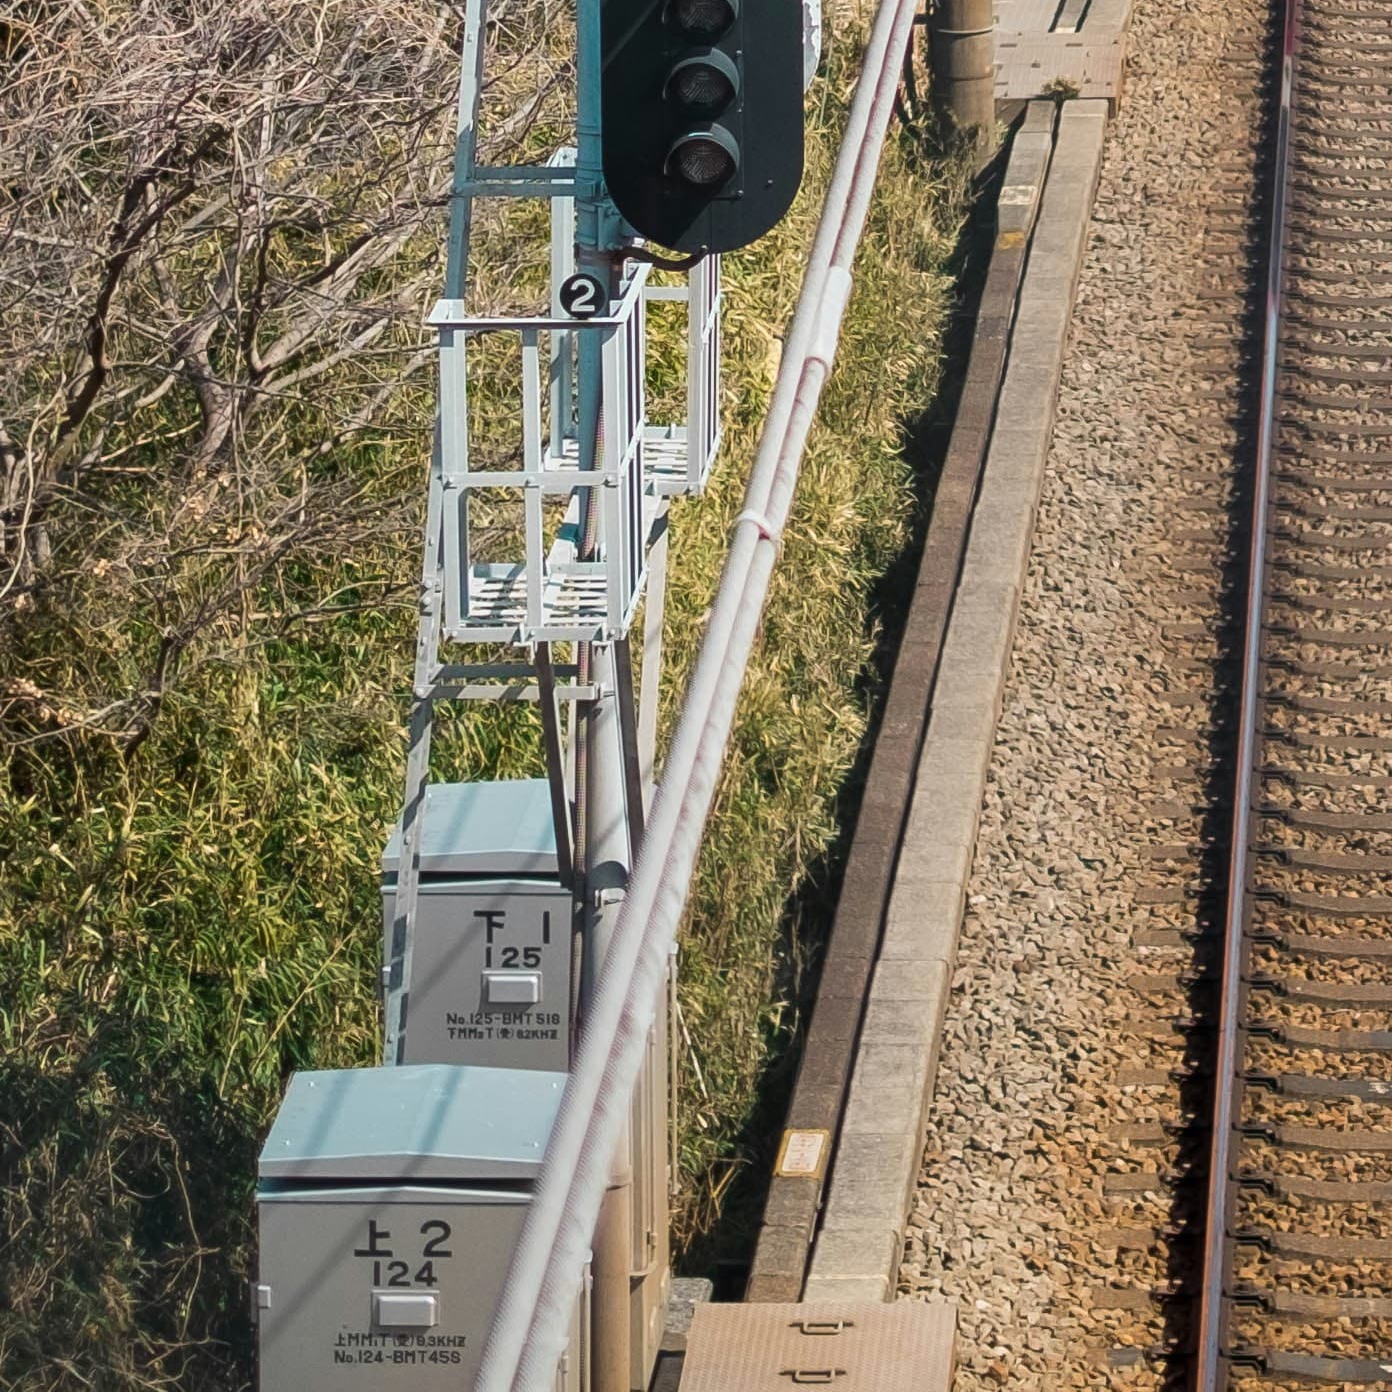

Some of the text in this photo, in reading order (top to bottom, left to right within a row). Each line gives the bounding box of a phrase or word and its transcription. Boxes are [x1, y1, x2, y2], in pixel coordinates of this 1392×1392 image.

[571, 279, 595, 312] 2
[473, 910, 506, 944] 下
[485, 947, 542, 968] 125
[354, 1220, 452, 1257] 上 2
[373, 1260, 438, 1286] 124
